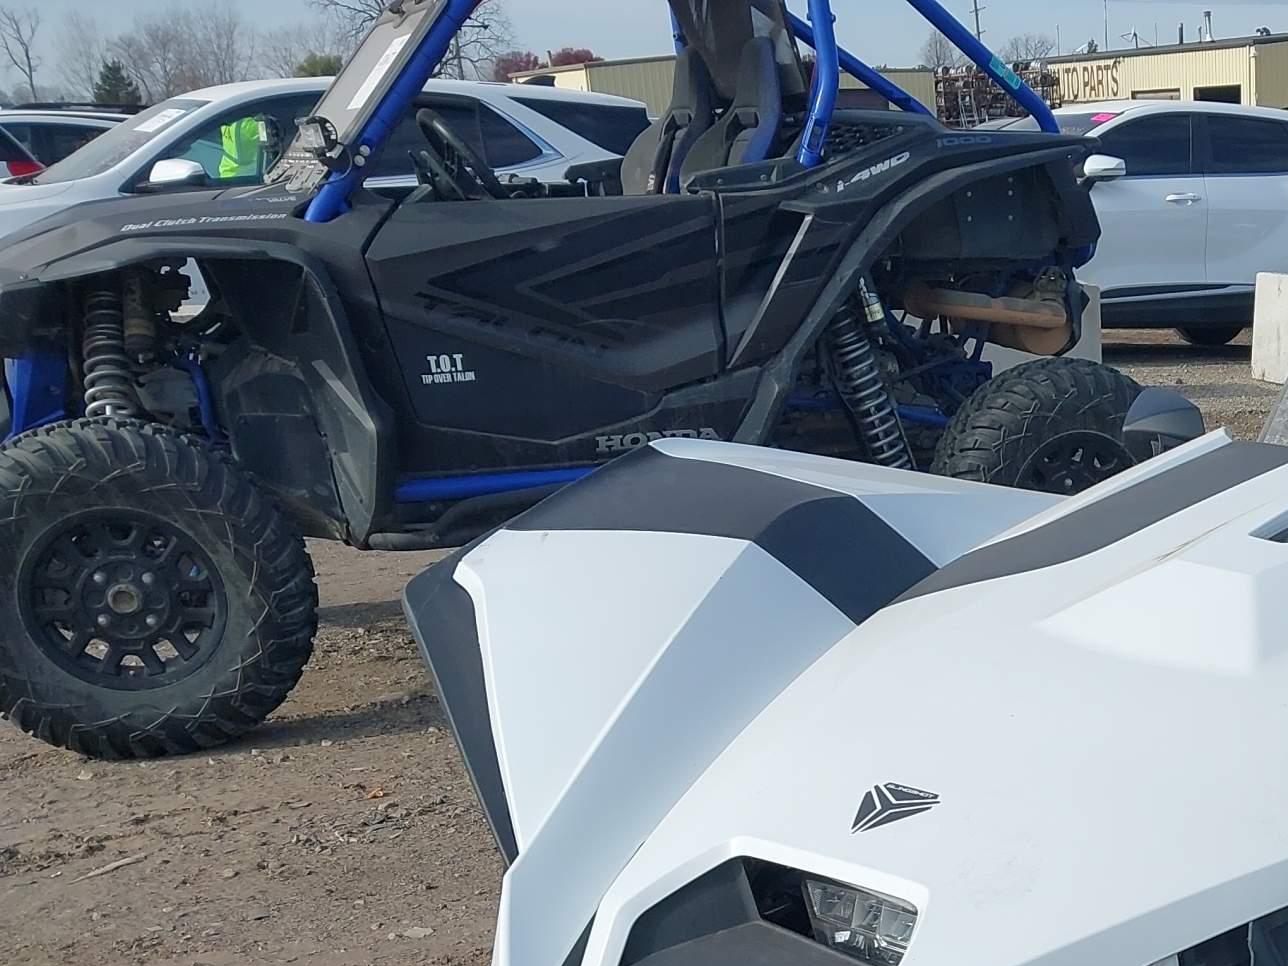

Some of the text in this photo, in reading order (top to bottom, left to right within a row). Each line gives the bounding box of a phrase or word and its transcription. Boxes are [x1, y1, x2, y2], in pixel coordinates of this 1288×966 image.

[1082, 59, 1119, 98] PARTS
[936, 135, 992, 148] 1000
[120, 213, 288, 232] Dual Clutch Transmission
[426, 353, 463, 373] T.O.T
[421, 371, 476, 385] TIP OVER TALON
